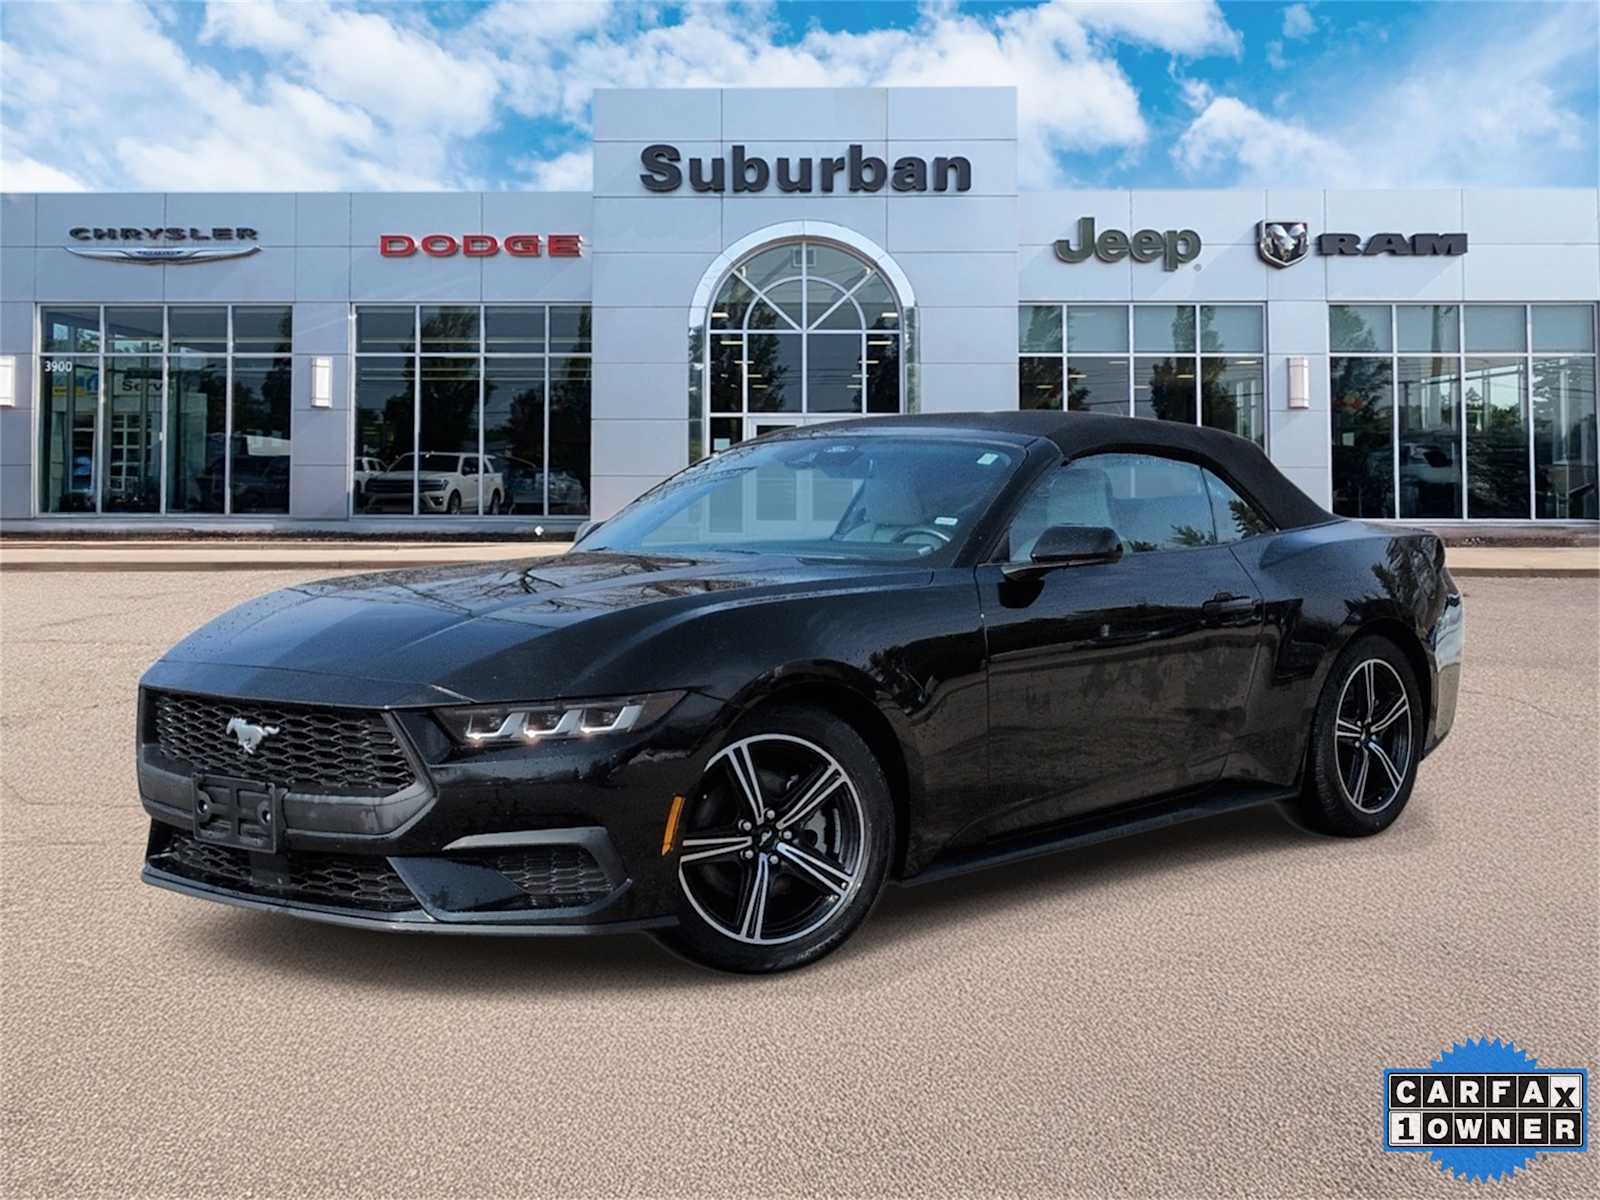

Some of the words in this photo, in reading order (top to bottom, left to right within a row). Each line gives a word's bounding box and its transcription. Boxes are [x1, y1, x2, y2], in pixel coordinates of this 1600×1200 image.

[640, 143, 972, 193] Suburban
[69, 227, 259, 241] CHRYSLER
[379, 234, 583, 257] DODGE
[1054, 216, 1202, 272] Jeep
[1316, 232, 1469, 256] RAM
[44, 360, 73, 373] 3900
